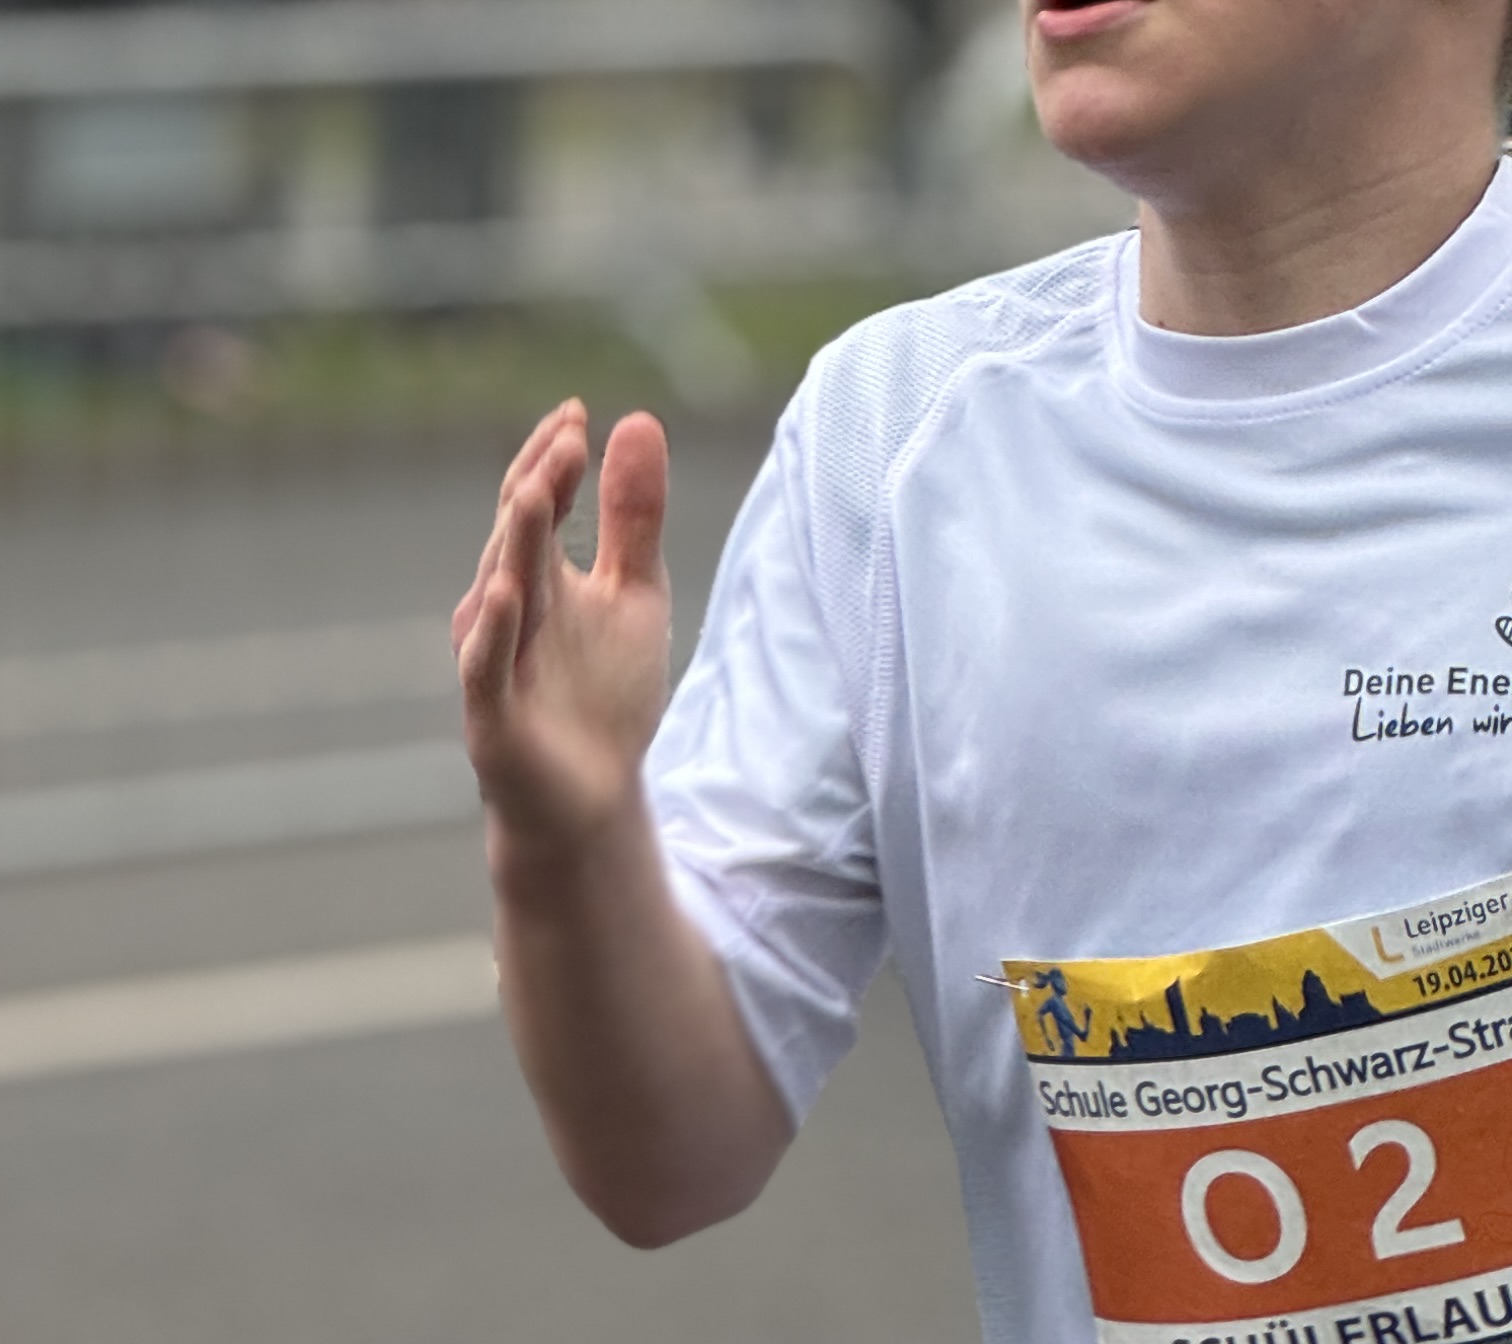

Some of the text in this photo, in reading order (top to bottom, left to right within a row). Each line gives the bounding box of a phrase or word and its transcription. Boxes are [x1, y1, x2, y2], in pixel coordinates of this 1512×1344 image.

[1343, 666, 1512, 697] Deine Ene
[1351, 696, 1512, 742] Lieben wir
[1403, 893, 1508, 938] Leipziger
[1412, 948, 1512, 997] 19.04.20
[1039, 1080, 1129, 1118] Schule
[1347, 1118, 1466, 1261] 2
